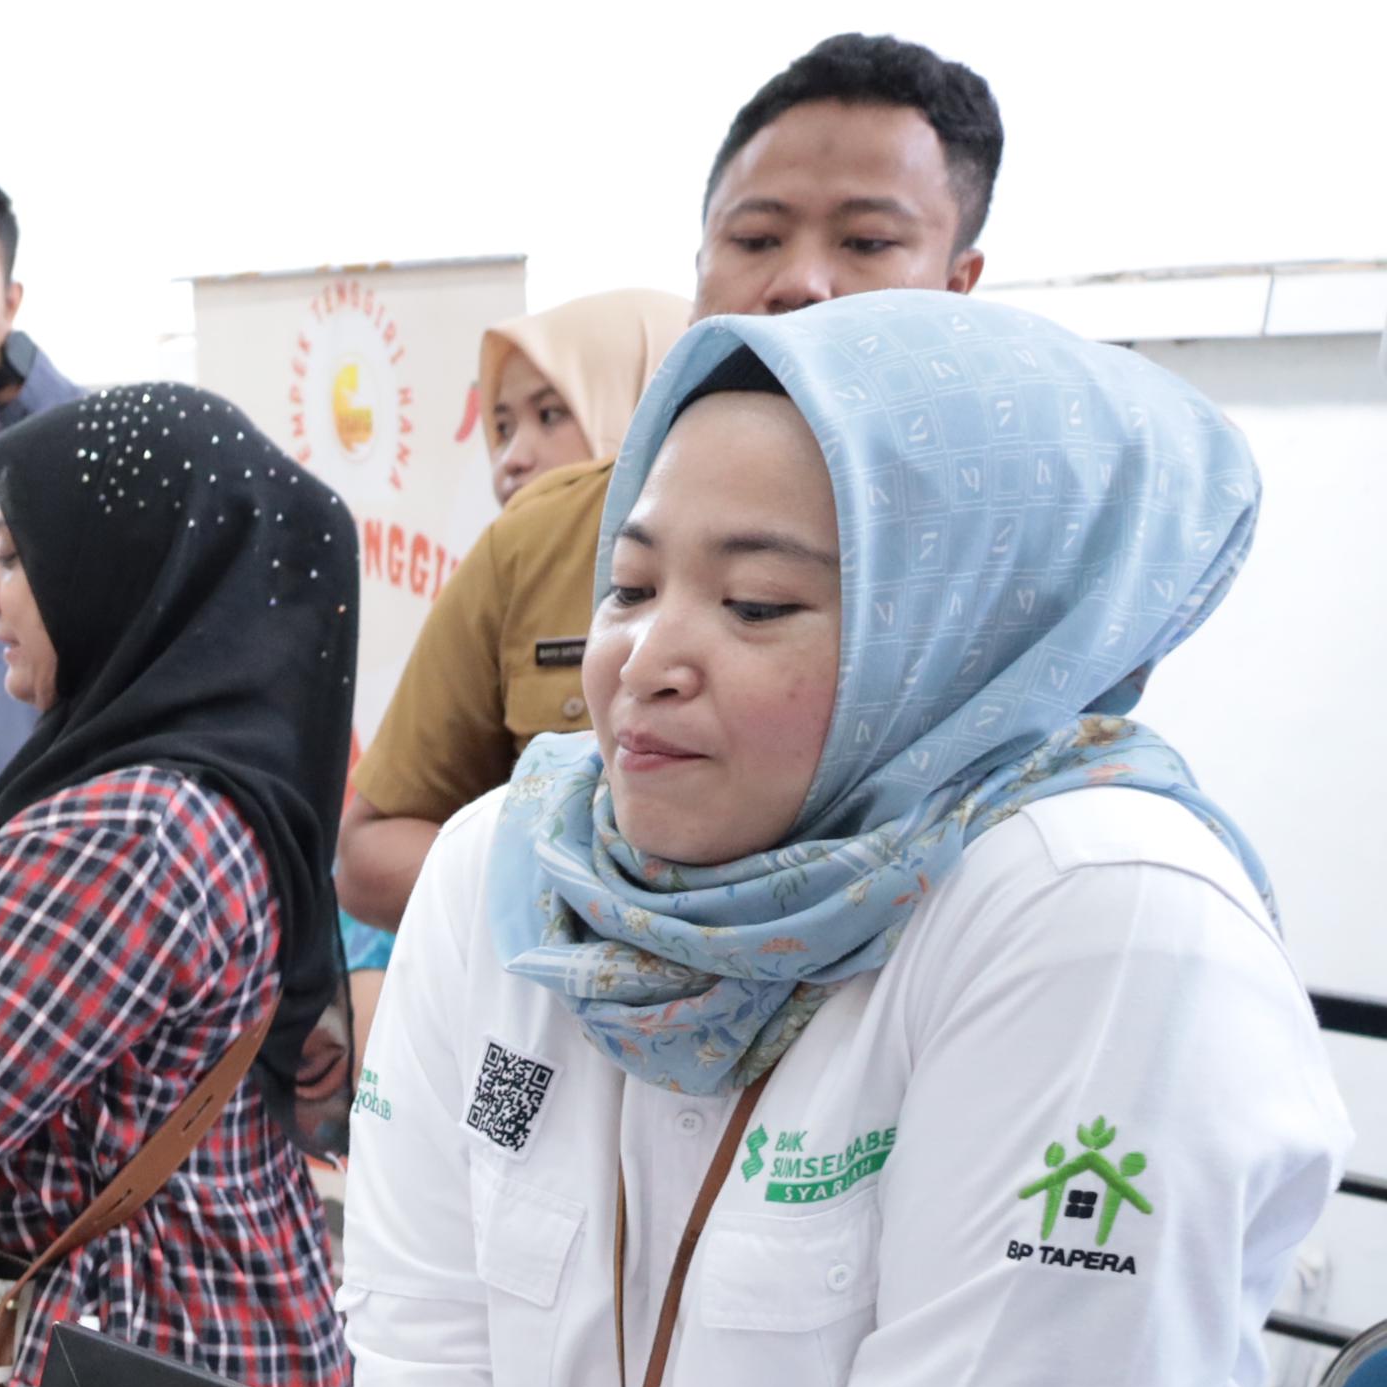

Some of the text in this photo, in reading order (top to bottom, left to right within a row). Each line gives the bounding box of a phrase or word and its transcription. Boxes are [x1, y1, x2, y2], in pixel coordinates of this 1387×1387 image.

[362, 518, 456, 604] NGGI
[1006, 1240, 1136, 1275] BP TAPERA
